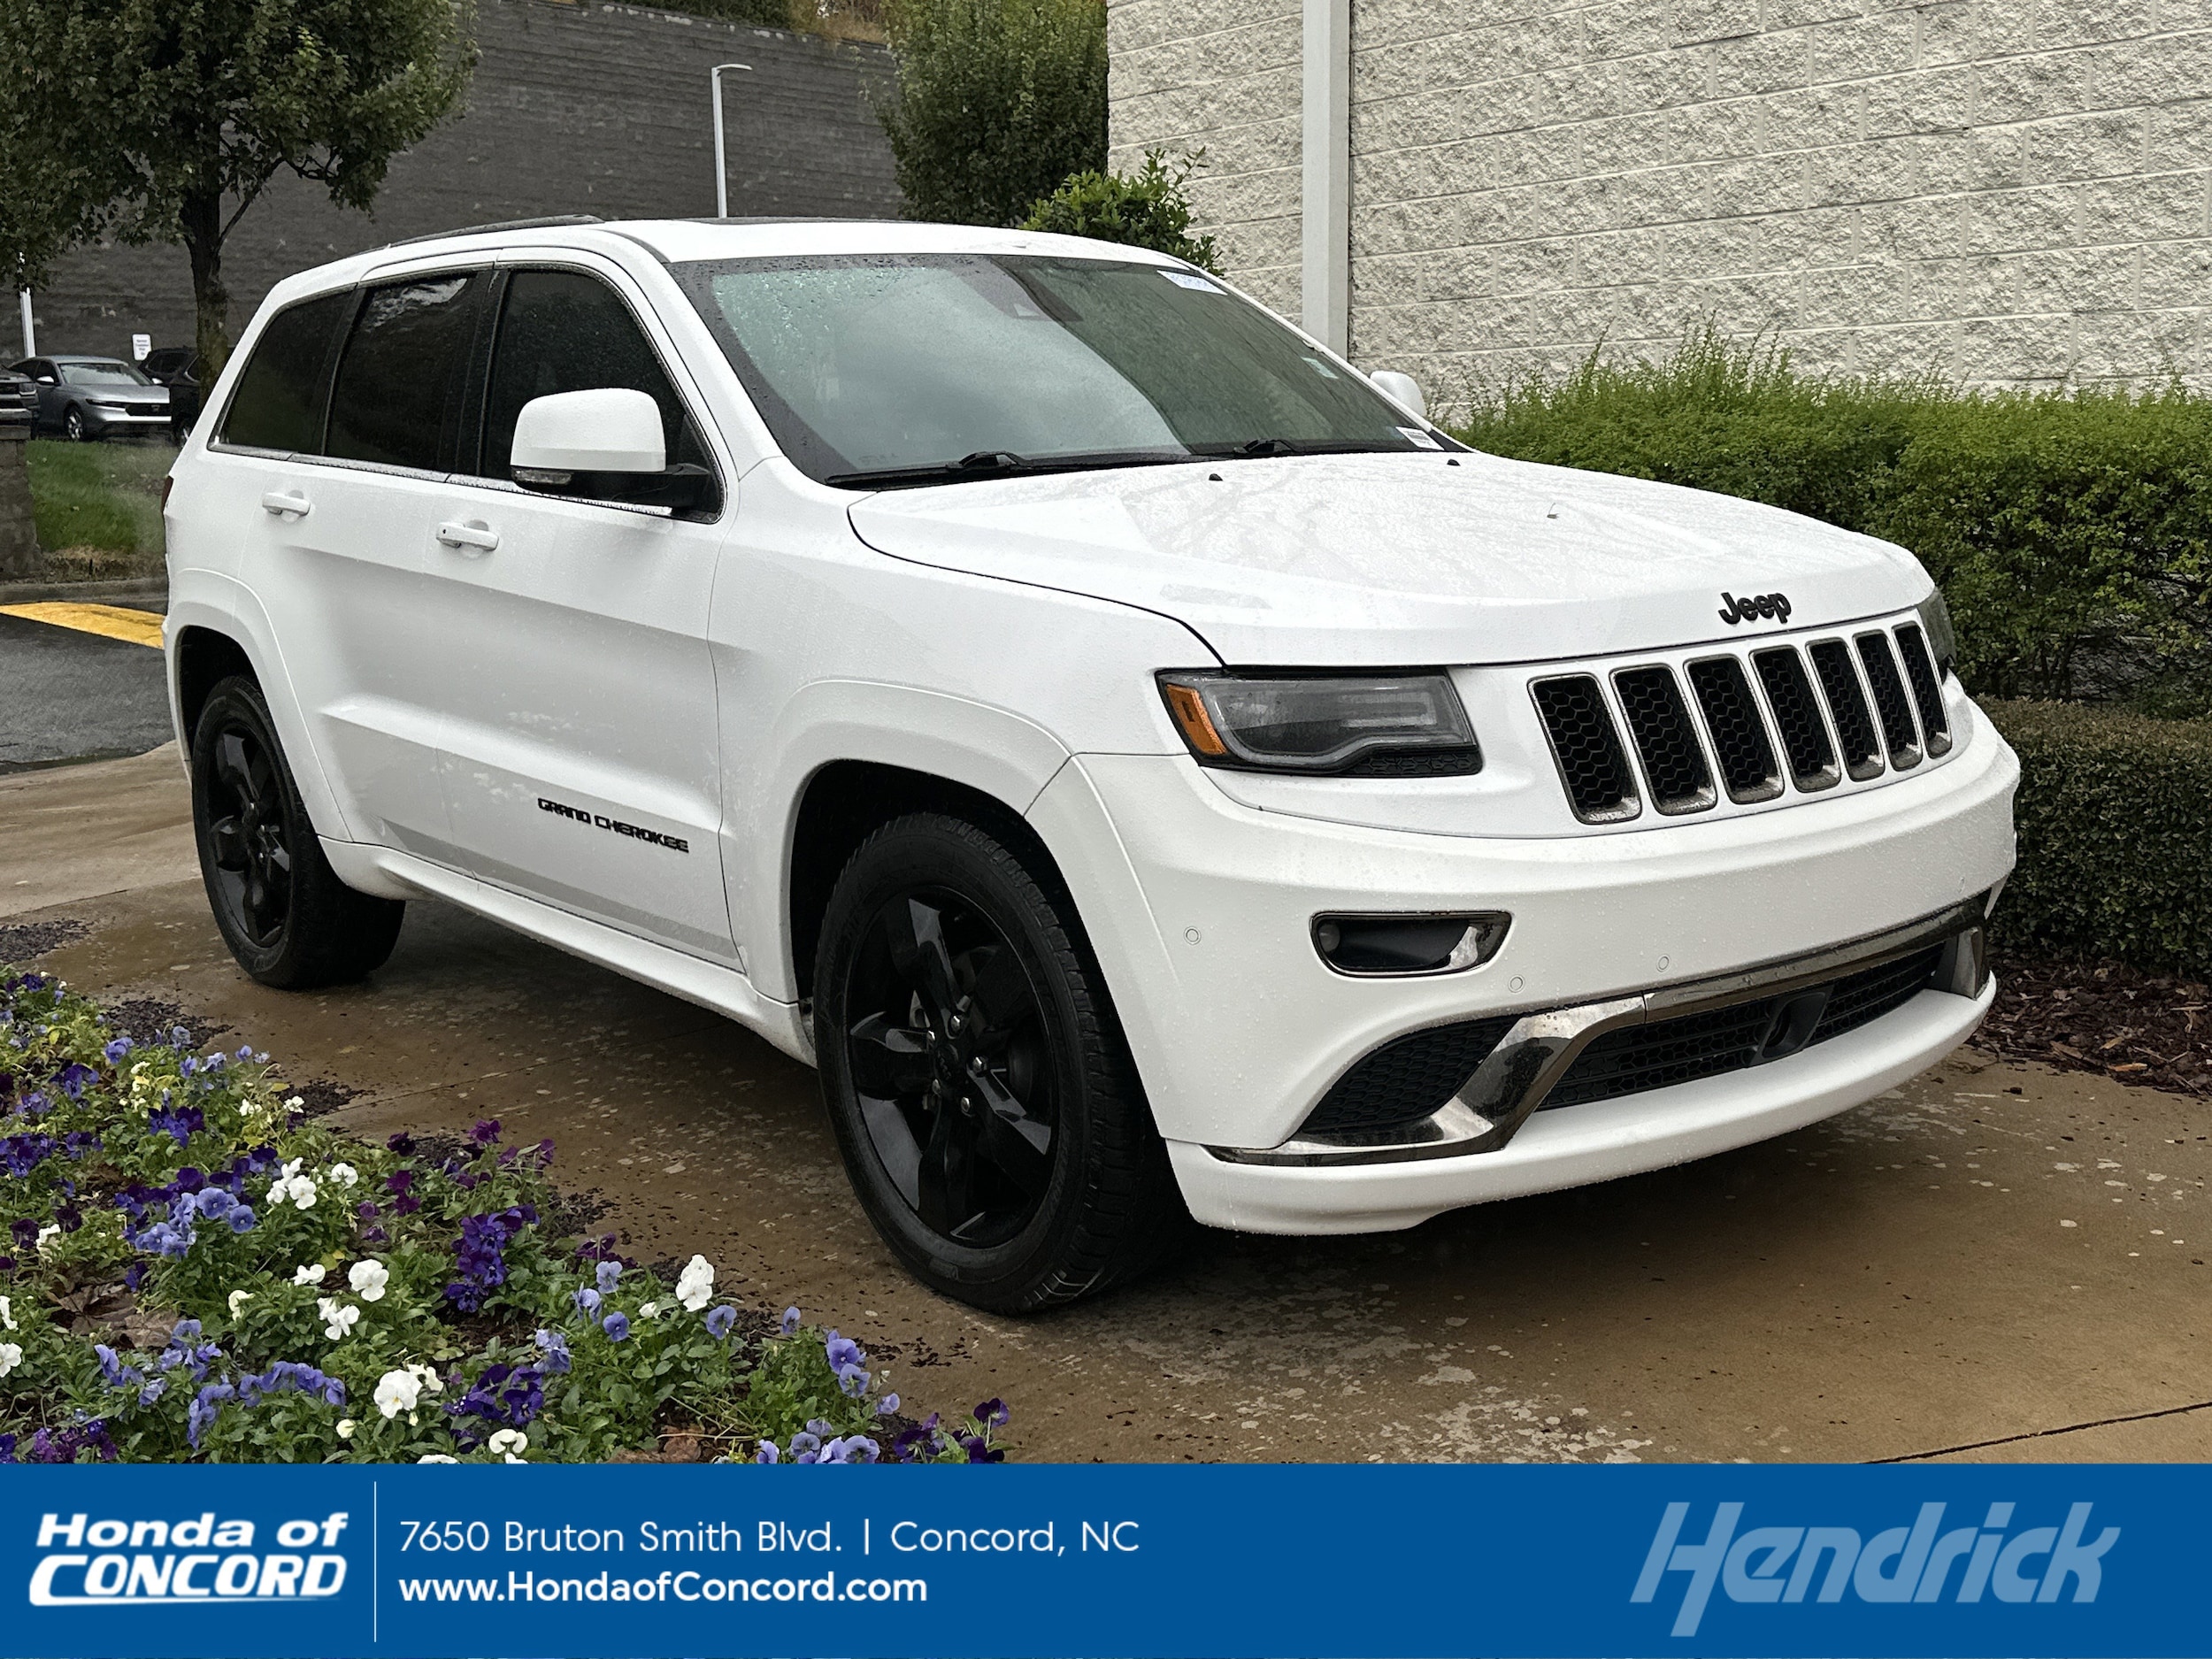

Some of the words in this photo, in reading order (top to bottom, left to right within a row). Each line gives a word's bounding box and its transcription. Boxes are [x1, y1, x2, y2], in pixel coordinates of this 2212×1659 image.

[1717, 592, 1792, 625] Jeep
[537, 797, 592, 825] GRAND
[594, 815, 689, 854] CHEROKEE
